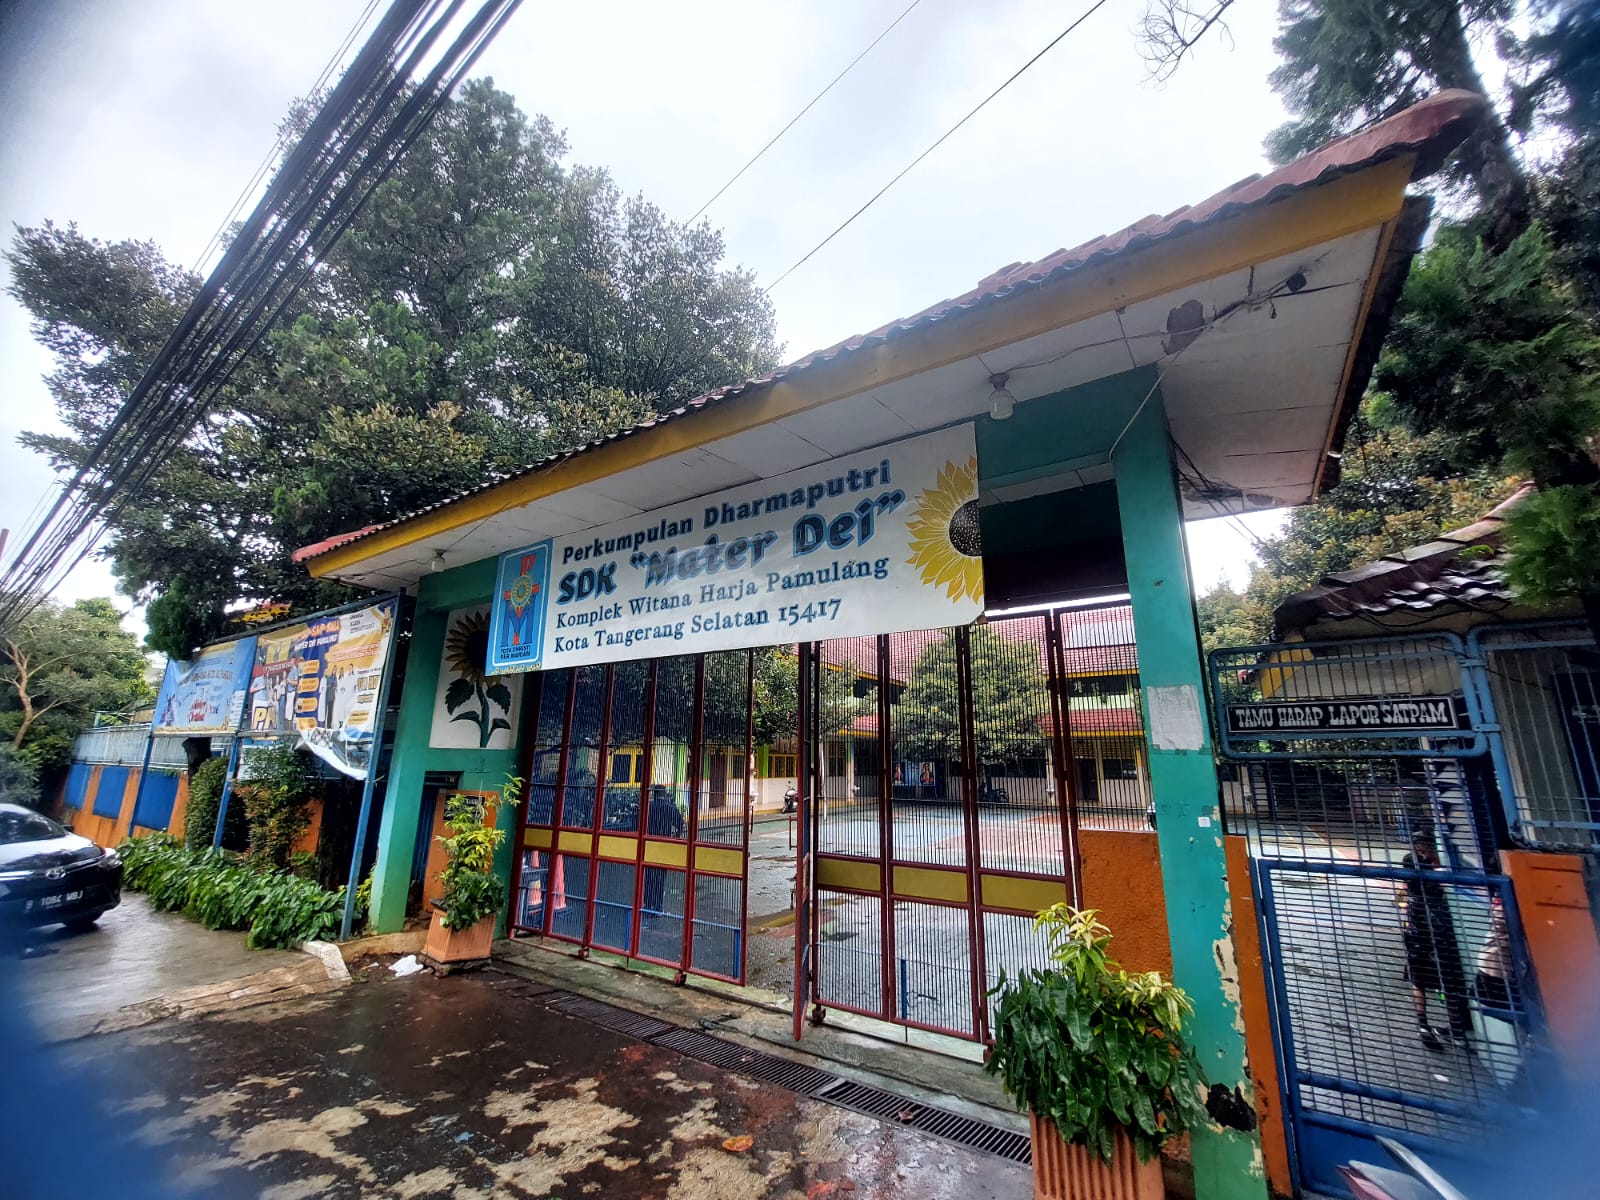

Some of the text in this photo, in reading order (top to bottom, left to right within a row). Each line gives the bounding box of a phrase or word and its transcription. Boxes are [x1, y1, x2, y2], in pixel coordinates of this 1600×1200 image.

[562, 459, 891, 564] Perkumpulan Dharmaputri
[556, 561, 617, 605] SDK
[556, 557, 890, 629] Komplek Witana Harja Pamulang
[554, 599, 842, 653] Kota Tangerang Selatan 15417
[1235, 702, 1449, 728] TAMU HARAP LAPOR SATPAM
